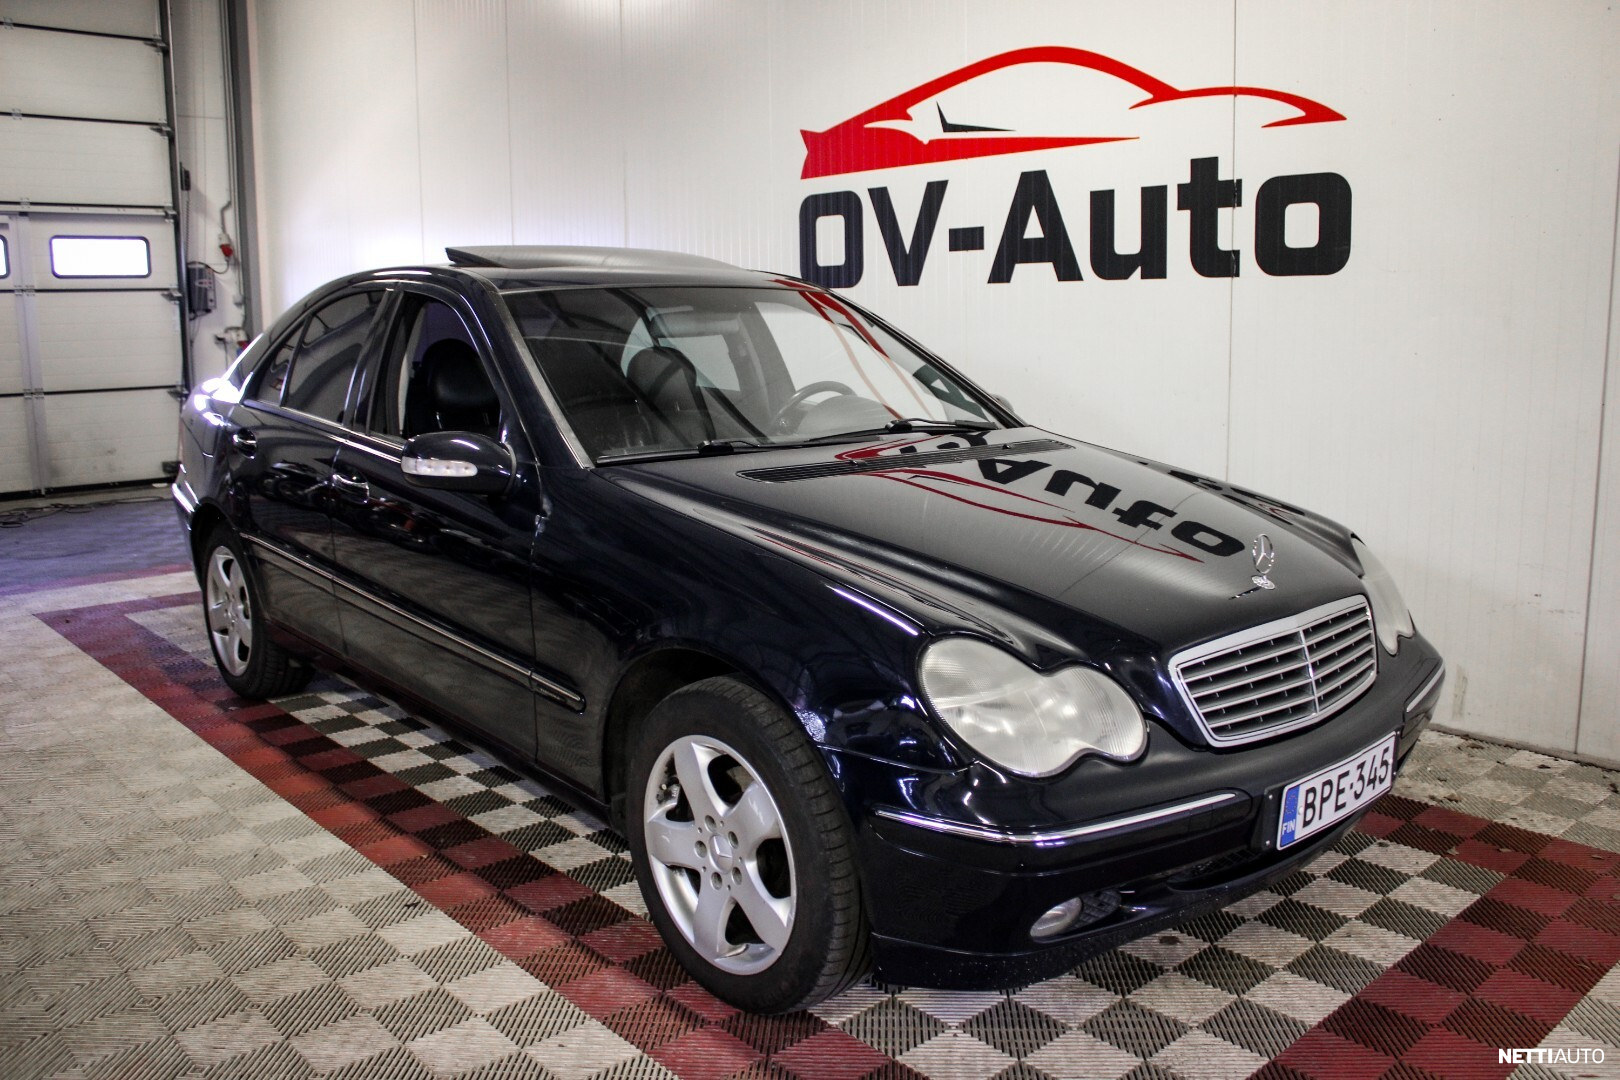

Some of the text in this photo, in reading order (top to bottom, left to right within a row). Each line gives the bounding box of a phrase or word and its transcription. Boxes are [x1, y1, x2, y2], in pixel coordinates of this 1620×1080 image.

[799, 156, 1352, 288] OV-Auto
[1282, 819, 1296, 835] FIN
[1302, 746, 1390, 828] BPE-345
